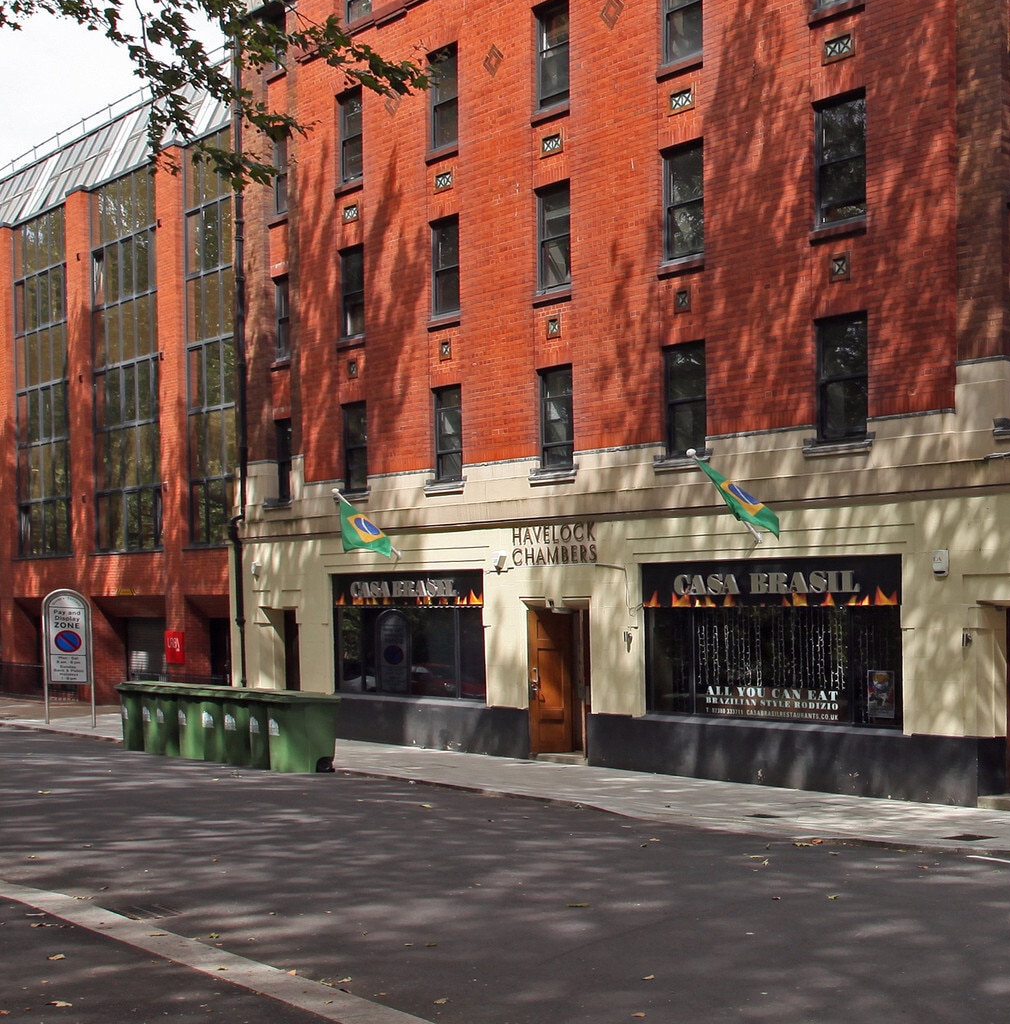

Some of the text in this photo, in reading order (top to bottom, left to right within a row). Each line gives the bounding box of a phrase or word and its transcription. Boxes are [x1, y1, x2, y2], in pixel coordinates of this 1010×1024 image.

[512, 521, 596, 546] HAVELOCK
[512, 544, 598, 566] CHAMBERS
[350, 578, 457, 597] CASA BRASIL
[673, 570, 861, 595] CASA BRASIL
[706, 685, 839, 701] ALL YOU CAN EAT
[706, 697, 839, 711] BRAZILIAN STYLE RODIZIO
